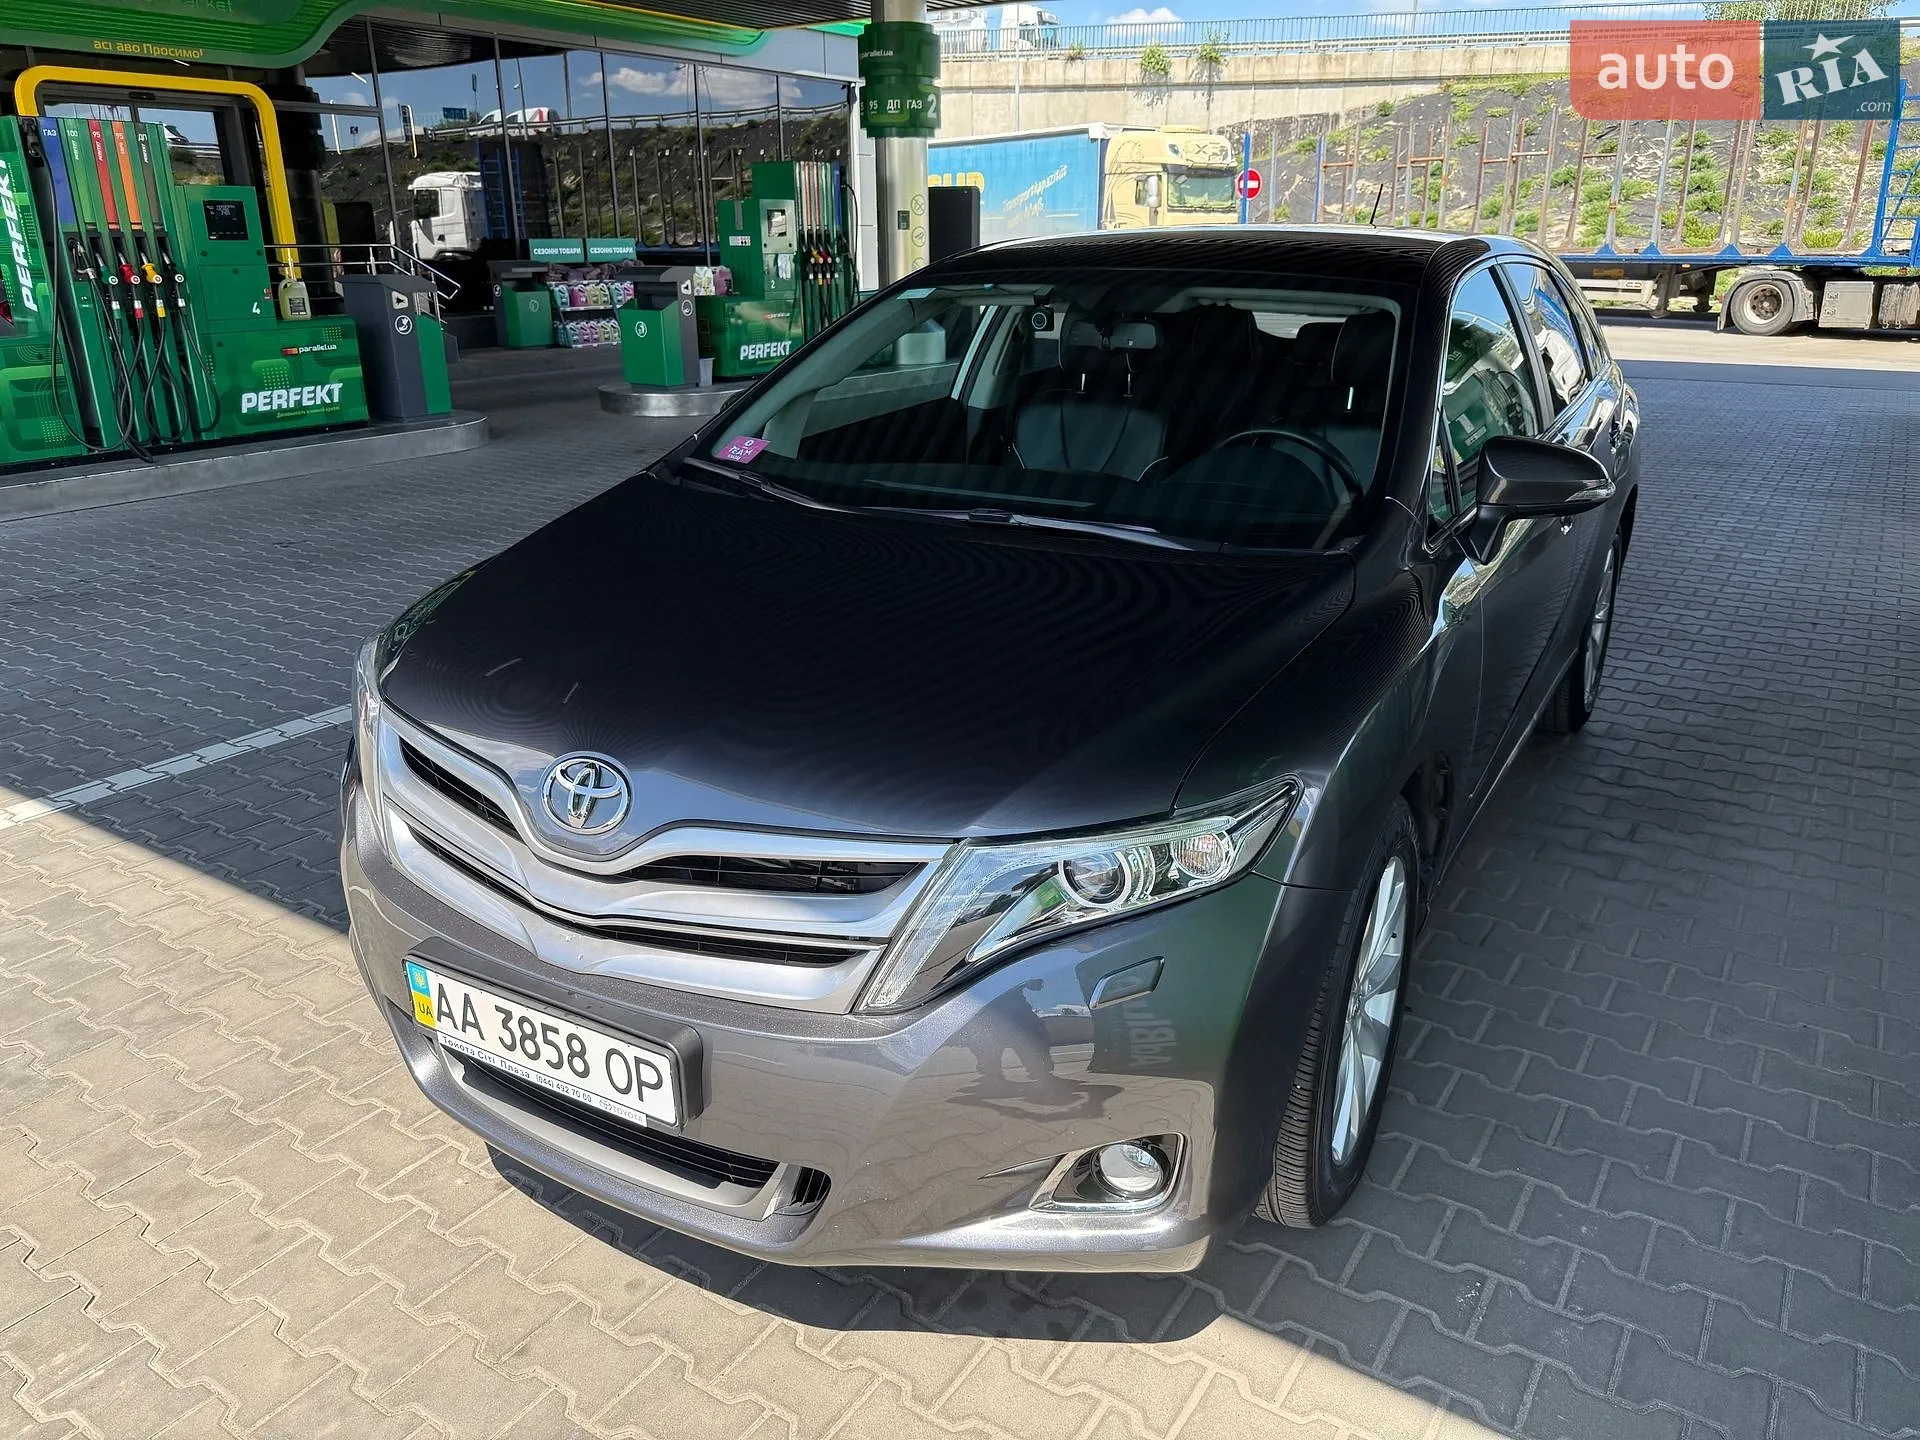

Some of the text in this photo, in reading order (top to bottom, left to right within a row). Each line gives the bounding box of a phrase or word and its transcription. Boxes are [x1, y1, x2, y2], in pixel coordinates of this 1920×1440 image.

[887, 99, 900, 111] ДП
[906, 99, 922, 109] ГАЗ
[927, 93, 937, 118] 2
[43, 129, 57, 137] ГАЗ
[92, 130, 101, 138] 95
[770, 280, 776, 289] 2
[252, 301, 261, 315] 4
[298, 344, 337, 354] parallel.ua
[740, 341, 792, 360] PERFEKT
[241, 383, 343, 413] PERFEKT
[418, 1002, 433, 1018] UA
[437, 982, 664, 1102] AA 3858 OP
[500, 1058, 531, 1079] Плаза
[556, 1081, 570, 1094] 492
[571, 1086, 581, 1098] 70
[612, 1105, 644, 1122] TOYOTA
